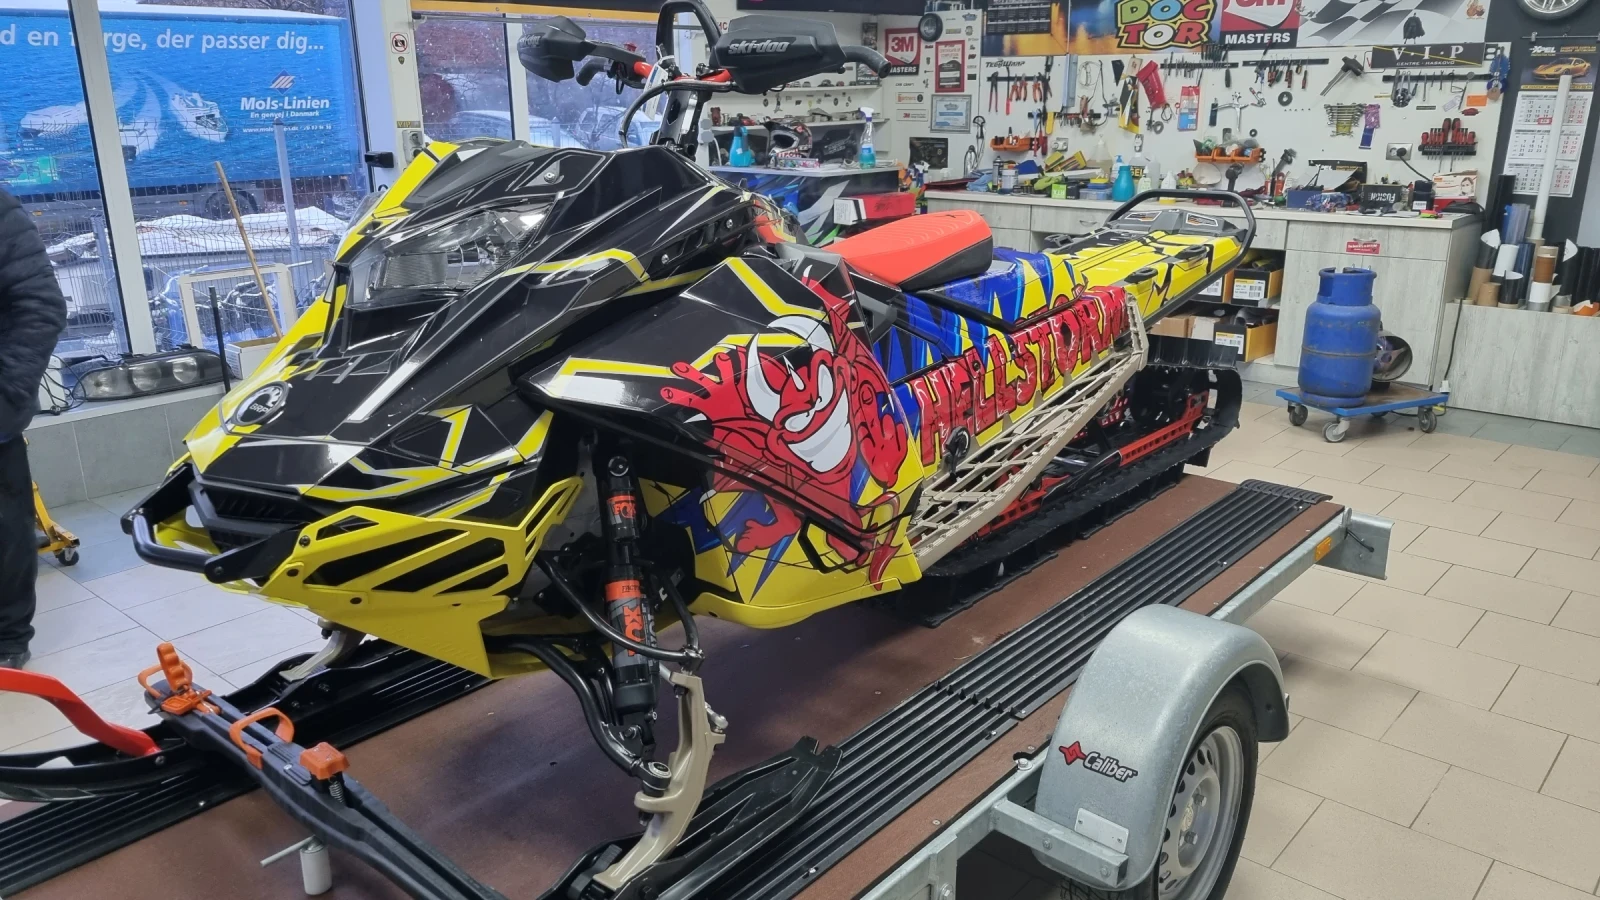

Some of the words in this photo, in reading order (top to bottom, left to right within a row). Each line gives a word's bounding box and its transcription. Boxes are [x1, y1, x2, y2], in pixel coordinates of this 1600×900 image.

[1120, 0, 1212, 24] DOC
[27, 30, 59, 46] en
[156, 29, 194, 49] der
[201, 33, 270, 53] passer
[276, 30, 324, 54] dig...
[1123, 22, 1204, 48] TOR
[1224, 32, 1291, 45] MASTERS
[728, 39, 791, 55] ski-doo
[891, 36, 914, 53] 3M
[240, 96, 330, 111] Mols-Linien
[261, 111, 284, 119] genvej
[911, 285, 1131, 466] HELLSTORM
[613, 502, 637, 519] FOX
[1084, 751, 1134, 781] Caliber
